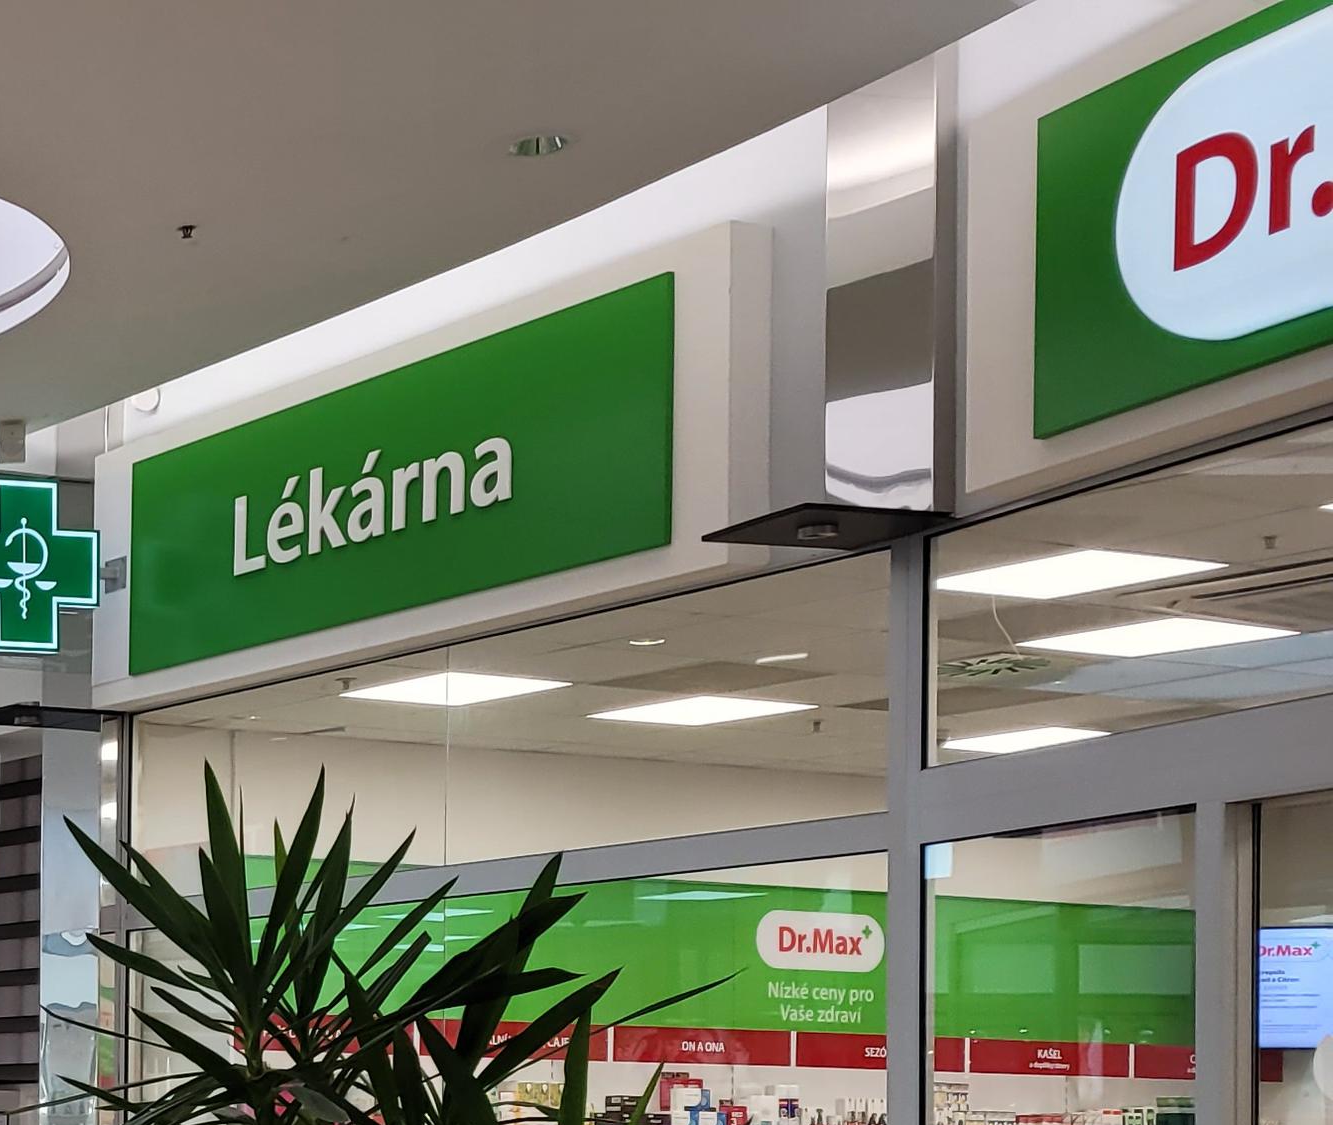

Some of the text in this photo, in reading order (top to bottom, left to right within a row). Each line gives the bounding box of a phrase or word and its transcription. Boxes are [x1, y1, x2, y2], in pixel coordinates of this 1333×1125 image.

[232, 435, 514, 578] Lékárna
[778, 926, 863, 956] Dr.Max
[767, 981, 874, 1004] Nízké ceny pro
[780, 1003, 862, 1025] Vaše zdraví
[681, 1040, 725, 1053] ON A ONA
[1037, 1048, 1063, 1060] KAŠEL
